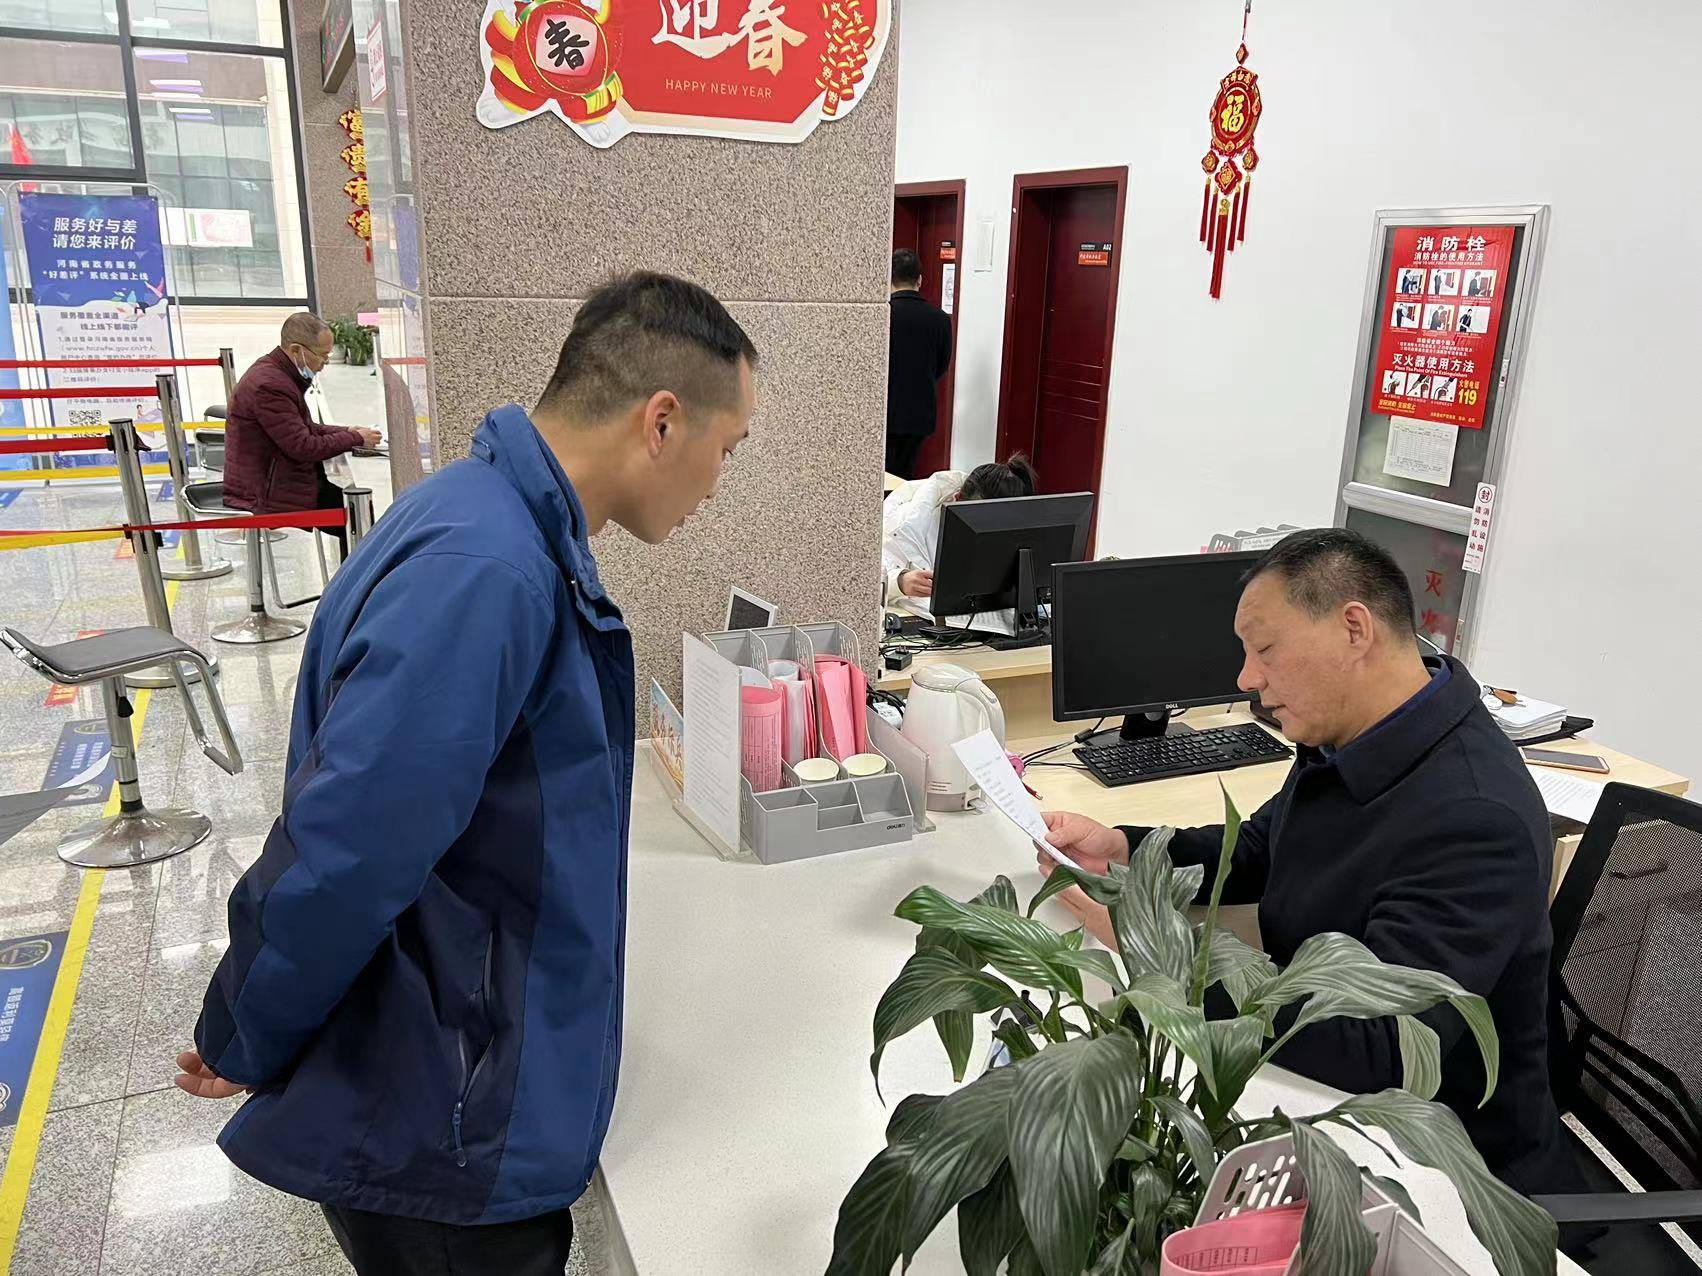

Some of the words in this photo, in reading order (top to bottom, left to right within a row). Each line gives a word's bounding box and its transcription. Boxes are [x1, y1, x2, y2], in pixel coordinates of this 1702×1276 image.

[544, 18, 590, 70] 春
[651, 0, 808, 77] 迎春
[665, 78, 706, 93] HAPPY
[711, 82, 738, 95] NEW
[742, 85, 773, 98] YEAR
[1221, 94, 1245, 132] 福
[54, 217, 138, 234] 服务好与差
[53, 234, 136, 250] 请您来评价
[1416, 235, 1487, 252] 消防栓
[57, 259, 137, 269] 河南省政务服务
[1413, 251, 1484, 262] 消防栓的使用方法
[1392, 353, 1475, 373] 灭火器使用方法
[1458, 389, 1477, 406] 119
[1481, 489, 1490, 501] 封
[1469, 505, 1482, 551] 请勿乱动
[1477, 507, 1490, 553] 消防设施
